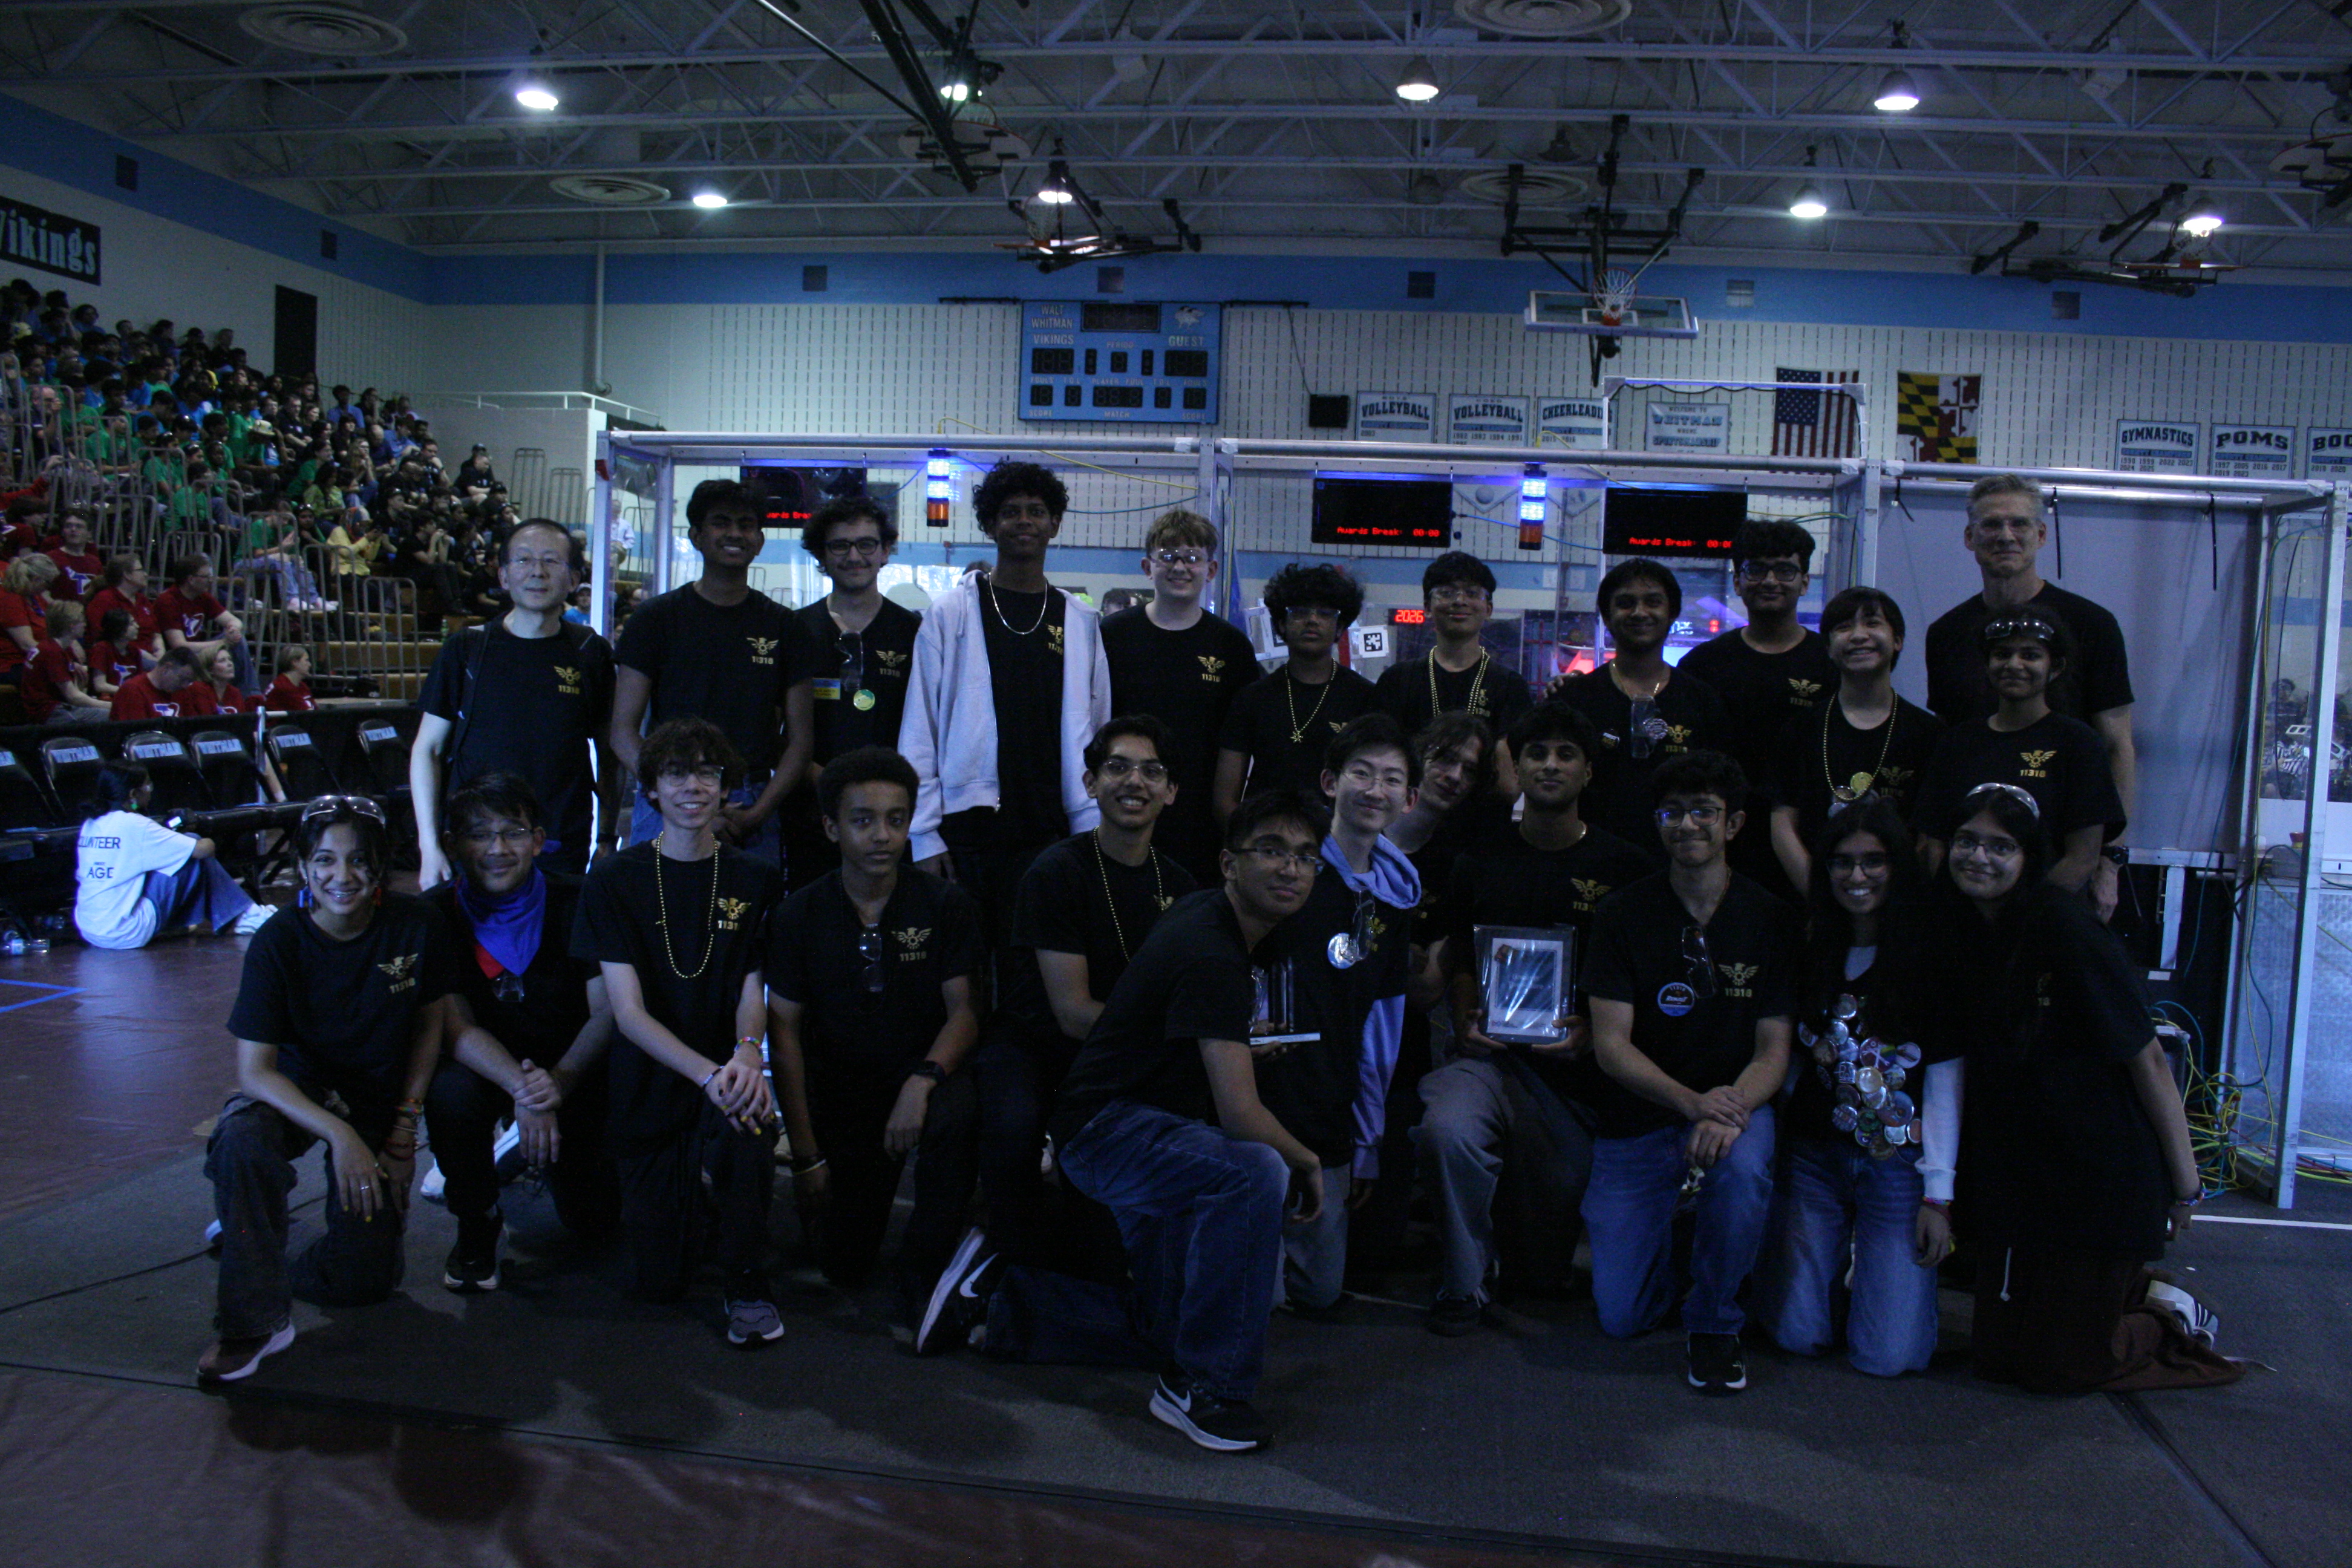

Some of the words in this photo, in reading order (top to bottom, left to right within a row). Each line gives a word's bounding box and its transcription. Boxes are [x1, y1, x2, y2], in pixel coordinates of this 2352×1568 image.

[1041, 304, 1065, 315] WALT
[1031, 318, 1073, 328] WHITMAN
[1033, 334, 1074, 345] VIKINGS
[1169, 336, 1204, 347] GUEST
[1362, 402, 1429, 420] VOLLEYBALL
[1454, 404, 1523, 422] VOLLEYBALL
[2122, 427, 2194, 446] GYMNASTICS
[2216, 431, 2288, 450] POMS
[1337, 526, 1369, 535] Awards
[1628, 537, 1662, 546] Awards
[1394, 609, 1426, 622] 2026
[87, 866, 115, 879] AGE
[1725, 987, 1753, 998] 11318
